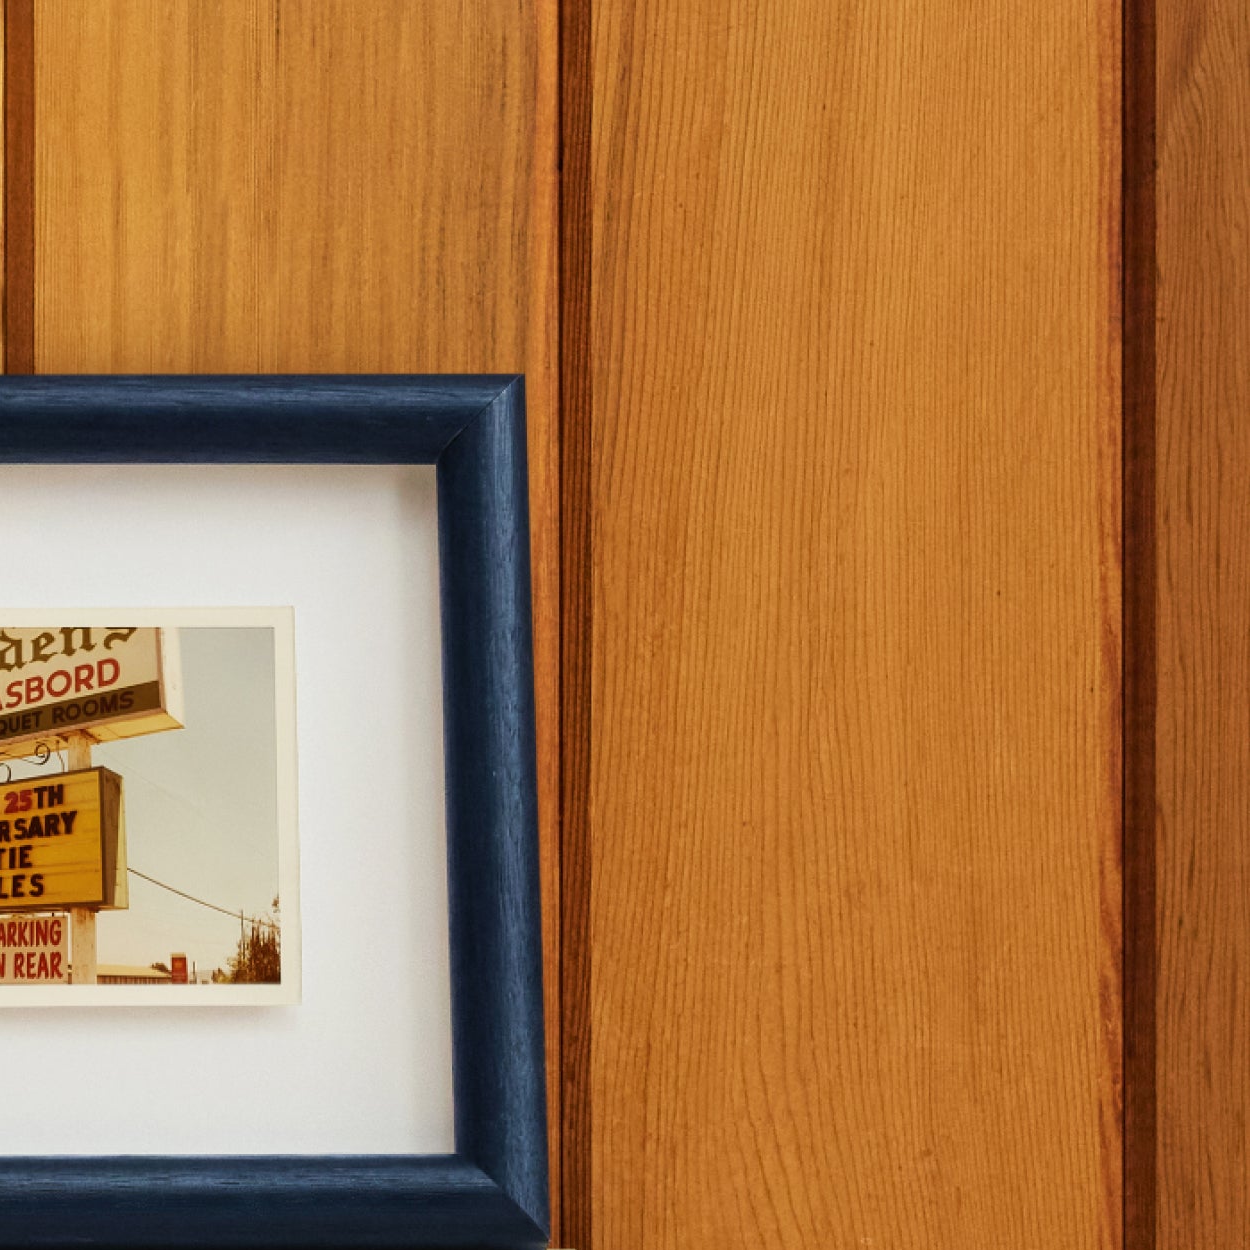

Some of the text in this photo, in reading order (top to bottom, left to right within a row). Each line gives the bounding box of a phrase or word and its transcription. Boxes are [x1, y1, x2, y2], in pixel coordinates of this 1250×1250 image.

[51, 690, 134, 723] ROOMS
[4, 784, 64, 814] 25TH
[14, 951, 64, 980] REAR
